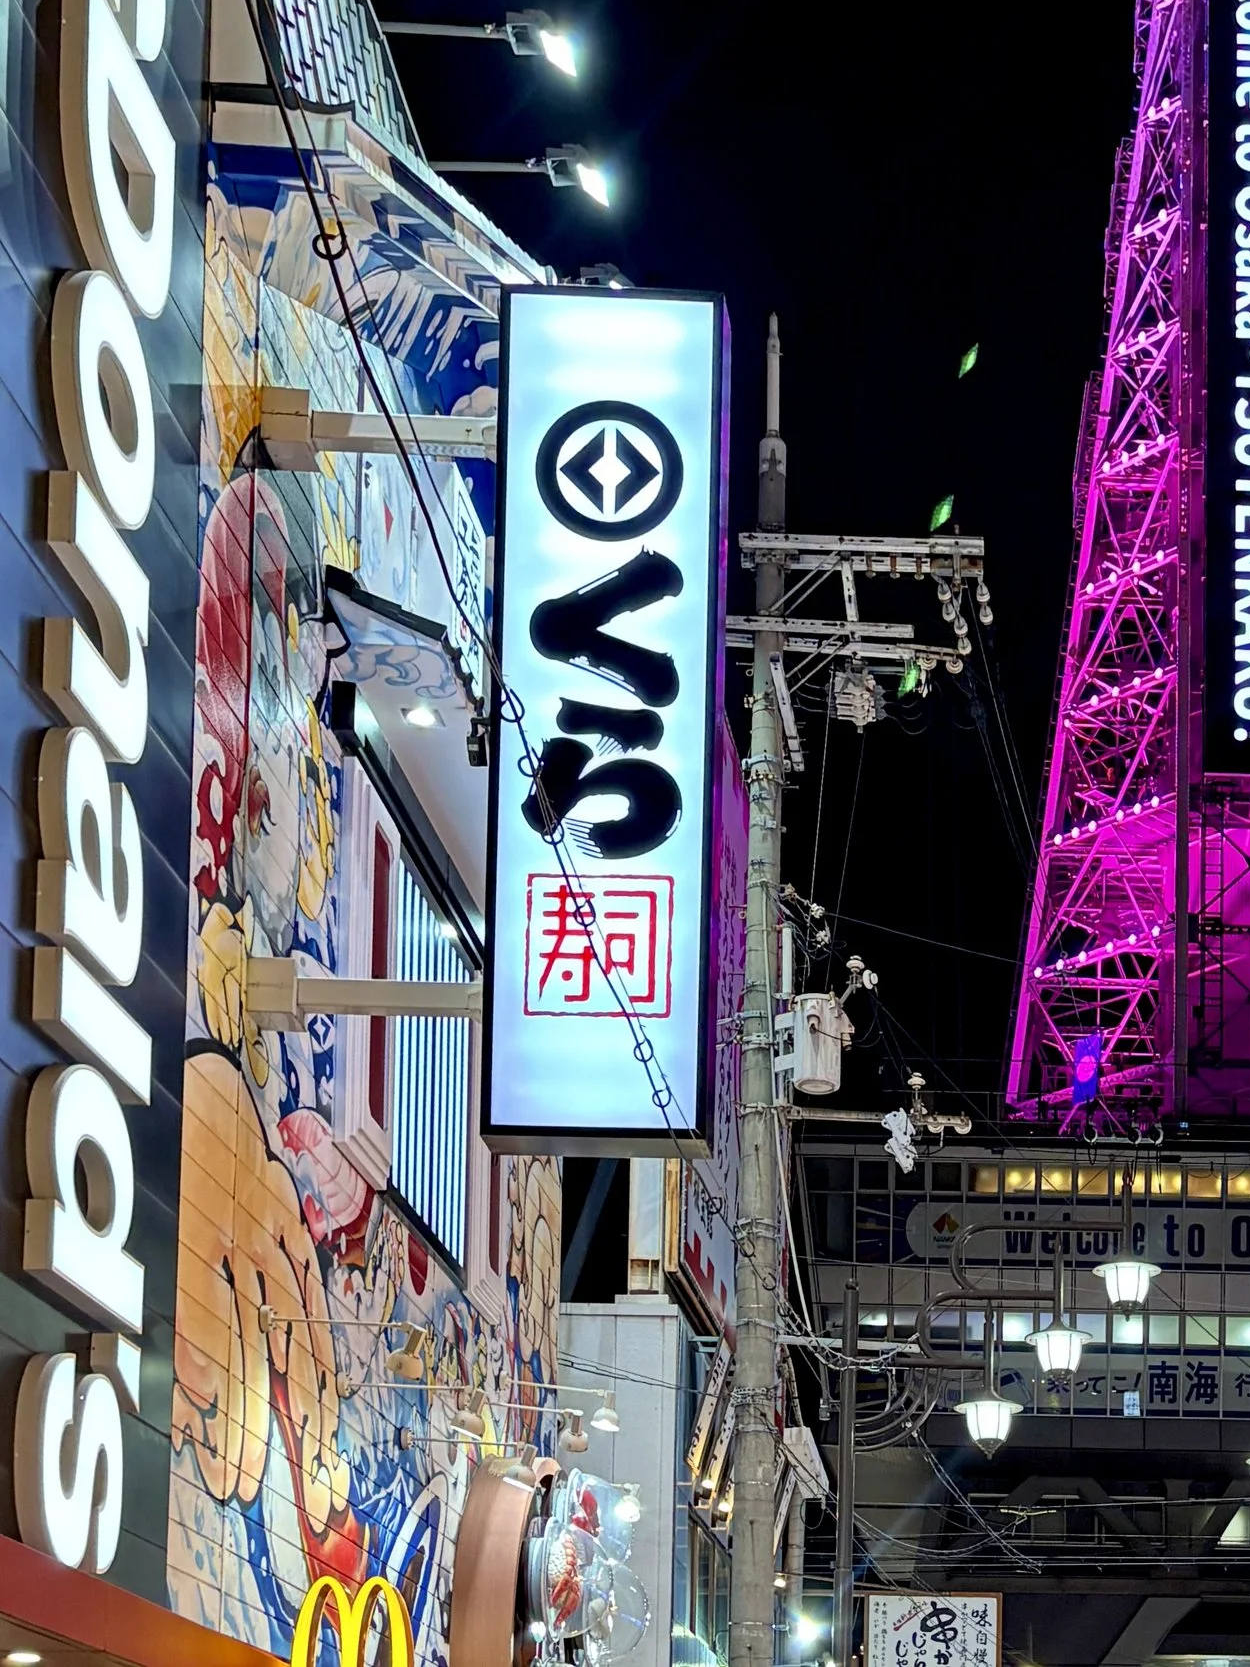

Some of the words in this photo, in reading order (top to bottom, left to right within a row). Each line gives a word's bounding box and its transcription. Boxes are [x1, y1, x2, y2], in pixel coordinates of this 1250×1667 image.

[521, 548, 685, 860] くら
[538, 884, 658, 1003] 寿司
[1163, 1214, 1205, 1258] to
[1147, 1360, 1220, 1406] 南海
